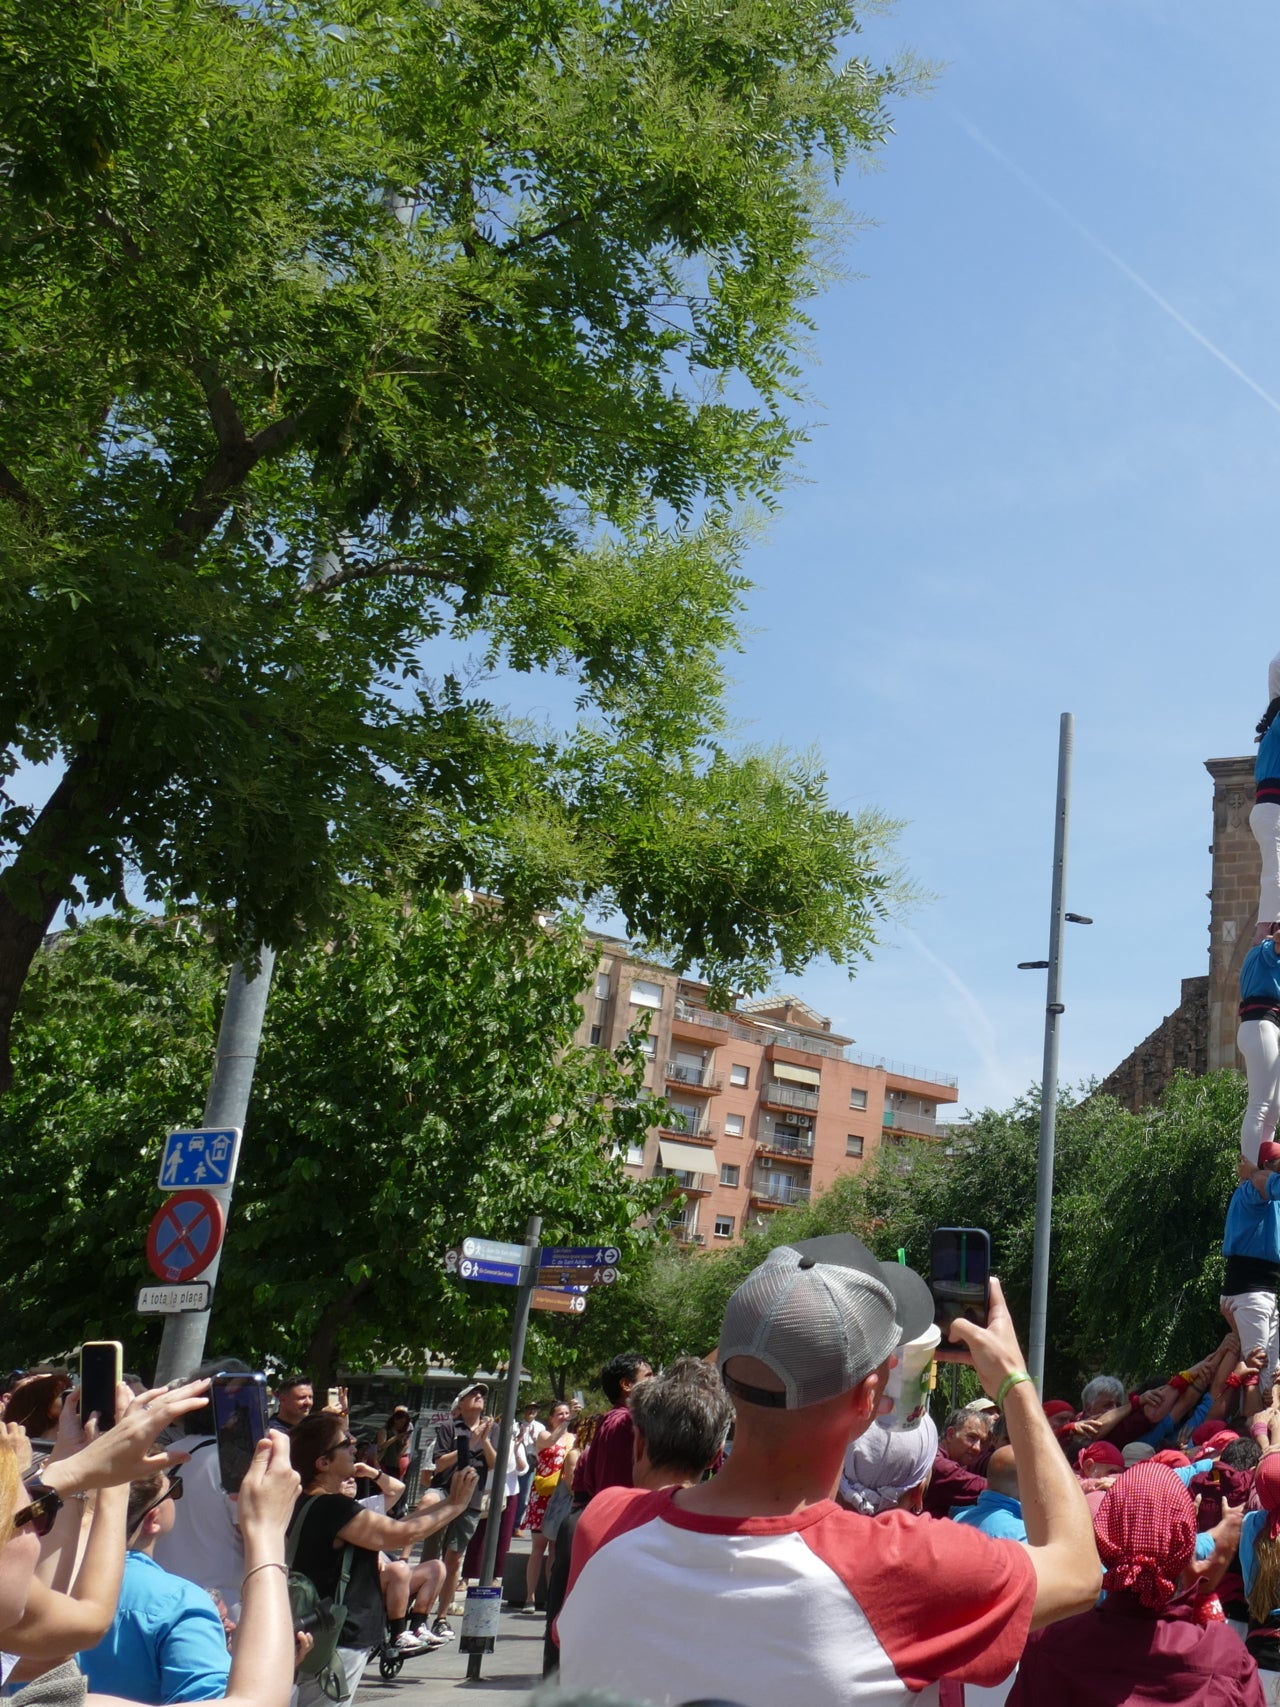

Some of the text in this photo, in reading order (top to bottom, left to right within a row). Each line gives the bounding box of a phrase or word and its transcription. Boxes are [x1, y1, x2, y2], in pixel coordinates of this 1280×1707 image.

[142, 1291, 203, 1306] A tota la plaça
